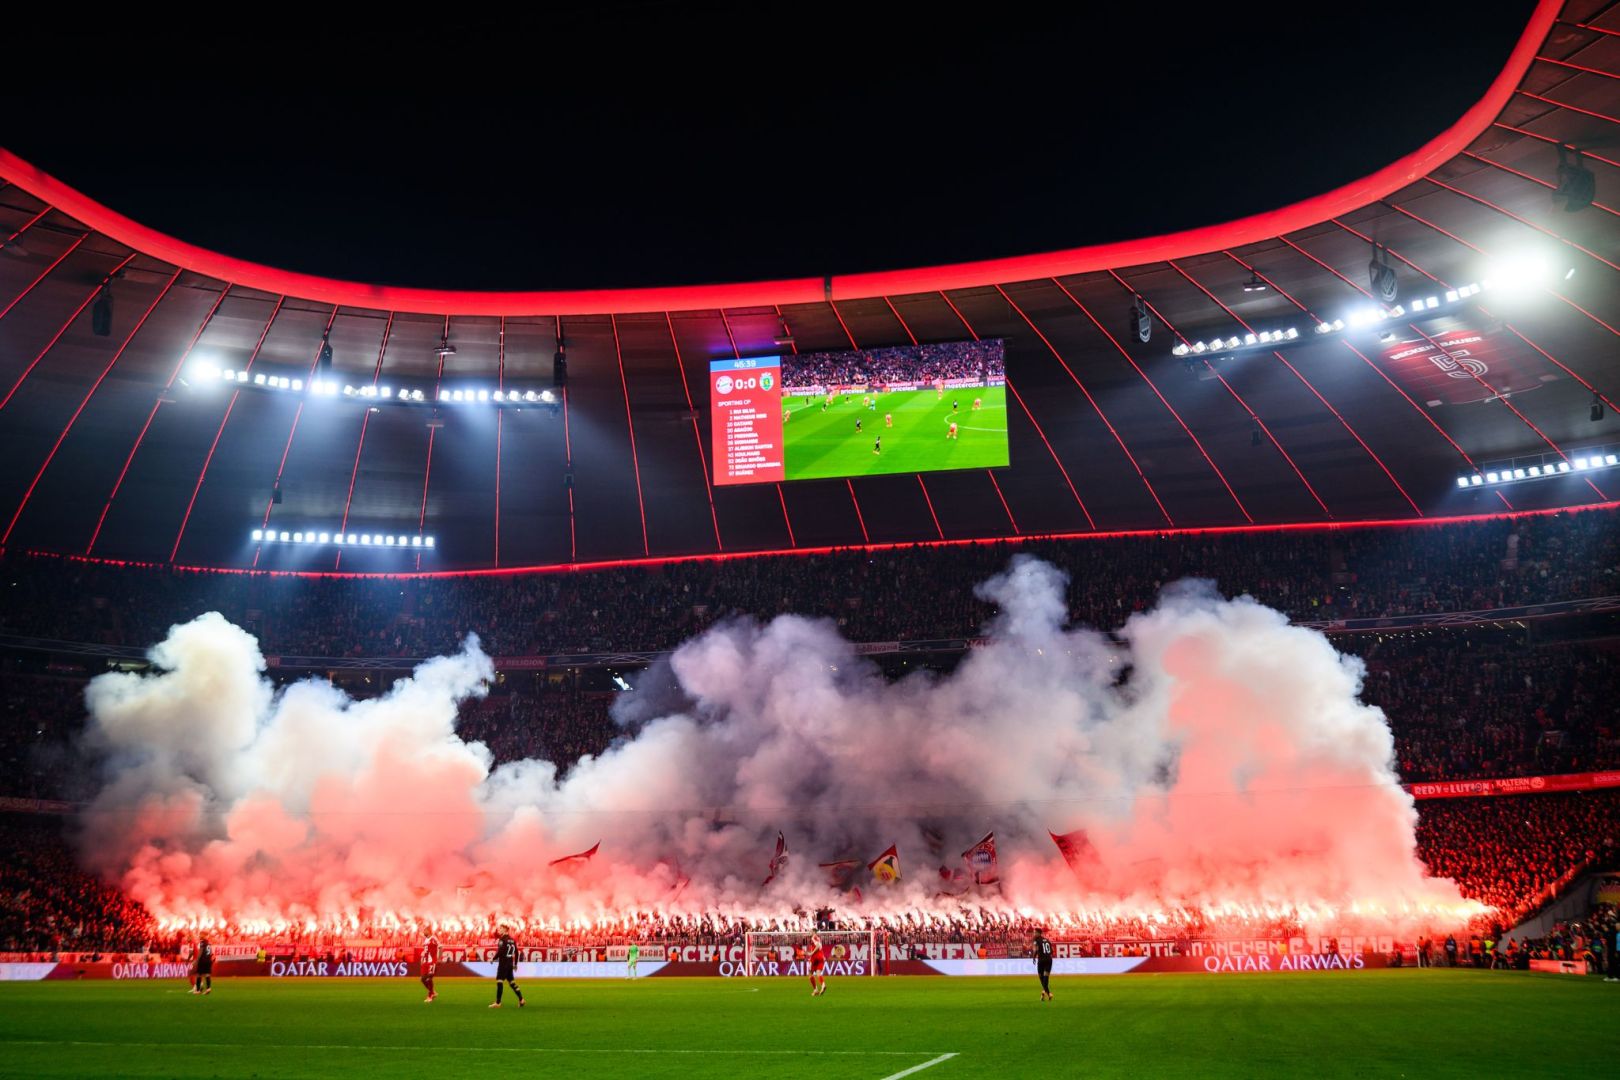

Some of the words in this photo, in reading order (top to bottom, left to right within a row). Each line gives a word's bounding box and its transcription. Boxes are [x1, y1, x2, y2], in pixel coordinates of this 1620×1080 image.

[1428, 349, 1488, 379] 5
[735, 377, 756, 390] 0:0
[271, 961, 329, 976] QATAR
[335, 961, 408, 976] AIRWAYS
[719, 961, 779, 977] QATAR
[1204, 955, 1271, 972] QATAR
[1279, 952, 1365, 970] AIRWAYS
[112, 962, 149, 979] QATAR
